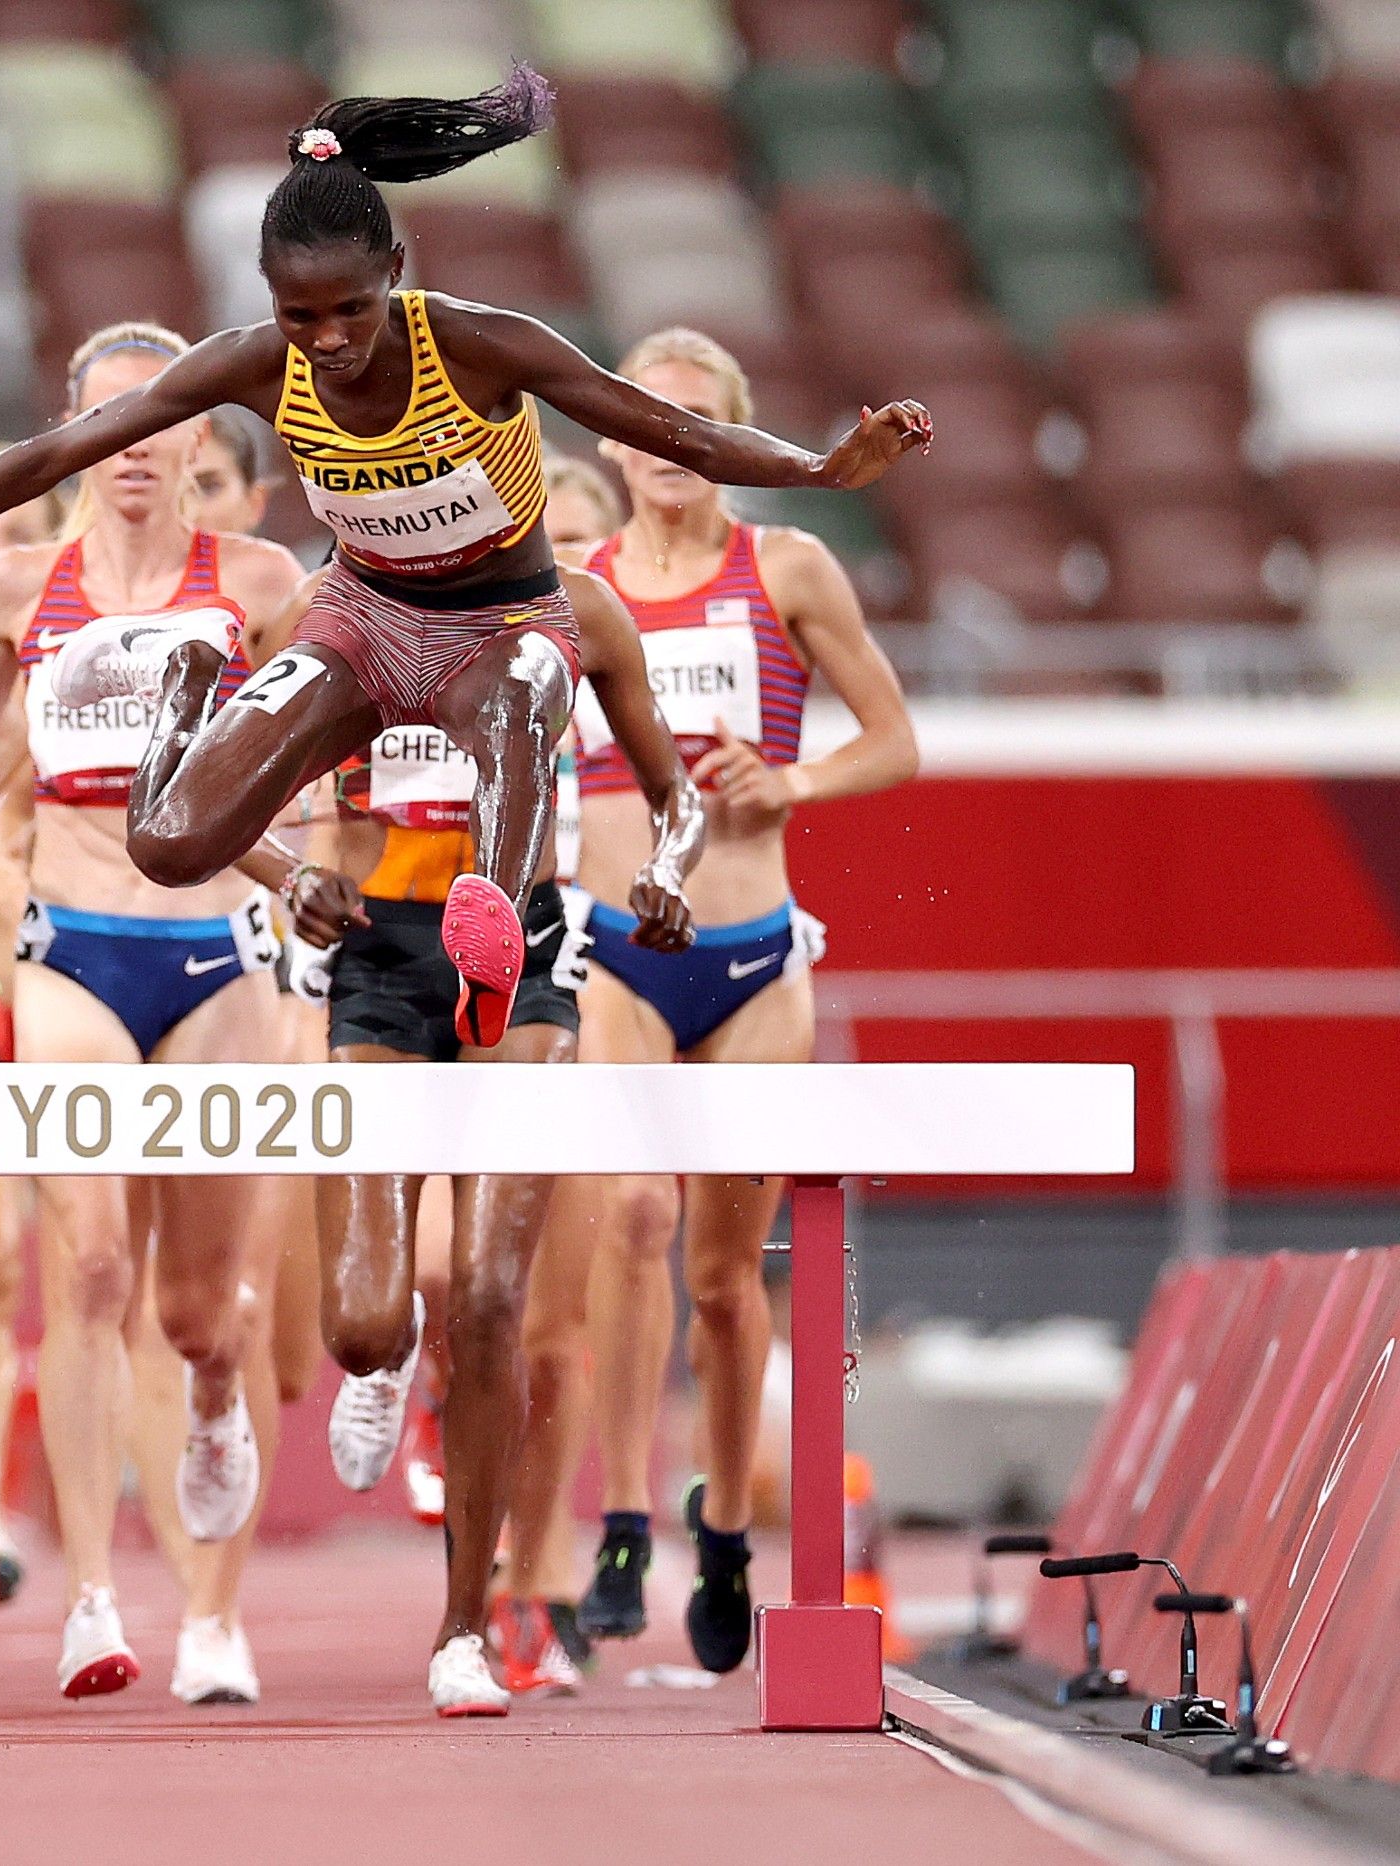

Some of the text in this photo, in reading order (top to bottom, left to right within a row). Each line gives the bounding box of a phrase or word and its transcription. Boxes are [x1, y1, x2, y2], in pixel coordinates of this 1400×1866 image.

[299, 456, 455, 491] UGANDA
[325, 495, 480, 538] CHEMUTAI
[237, 659, 298, 701] 2
[381, 733, 468, 764] CHEP
[141, 1083, 353, 1158] 2020
